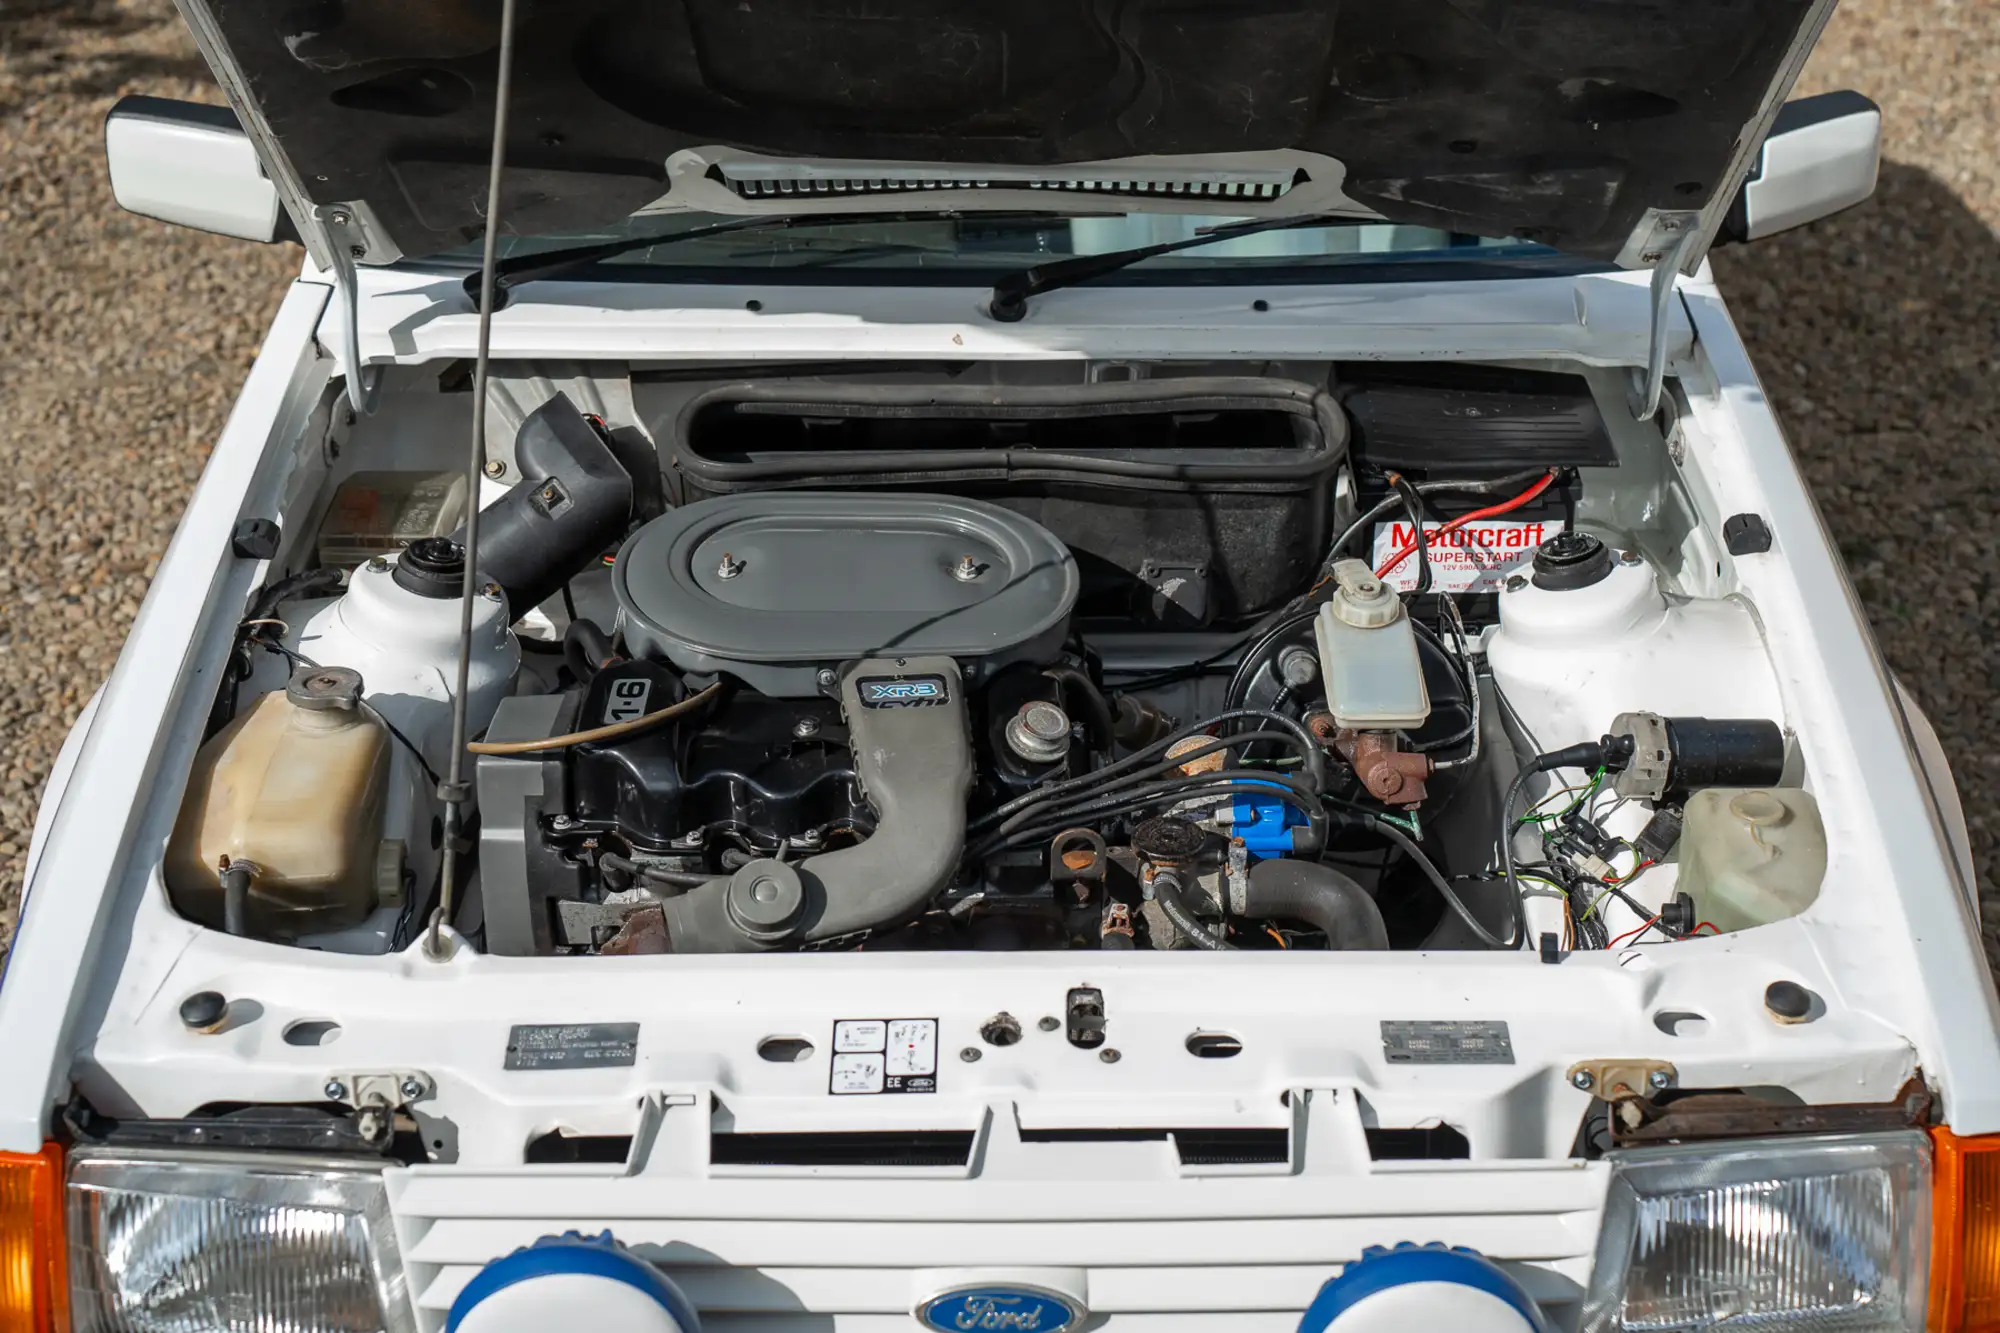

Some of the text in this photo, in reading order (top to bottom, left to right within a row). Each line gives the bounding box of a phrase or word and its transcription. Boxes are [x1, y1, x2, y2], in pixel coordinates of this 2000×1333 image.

[1391, 523, 1544, 548] Motorcraft
[1427, 552, 1523, 563] SUPERSTART
[870, 683, 938, 699] XR3
[887, 1077, 901, 1088] EE
[955, 1296, 1043, 1330] Ford
